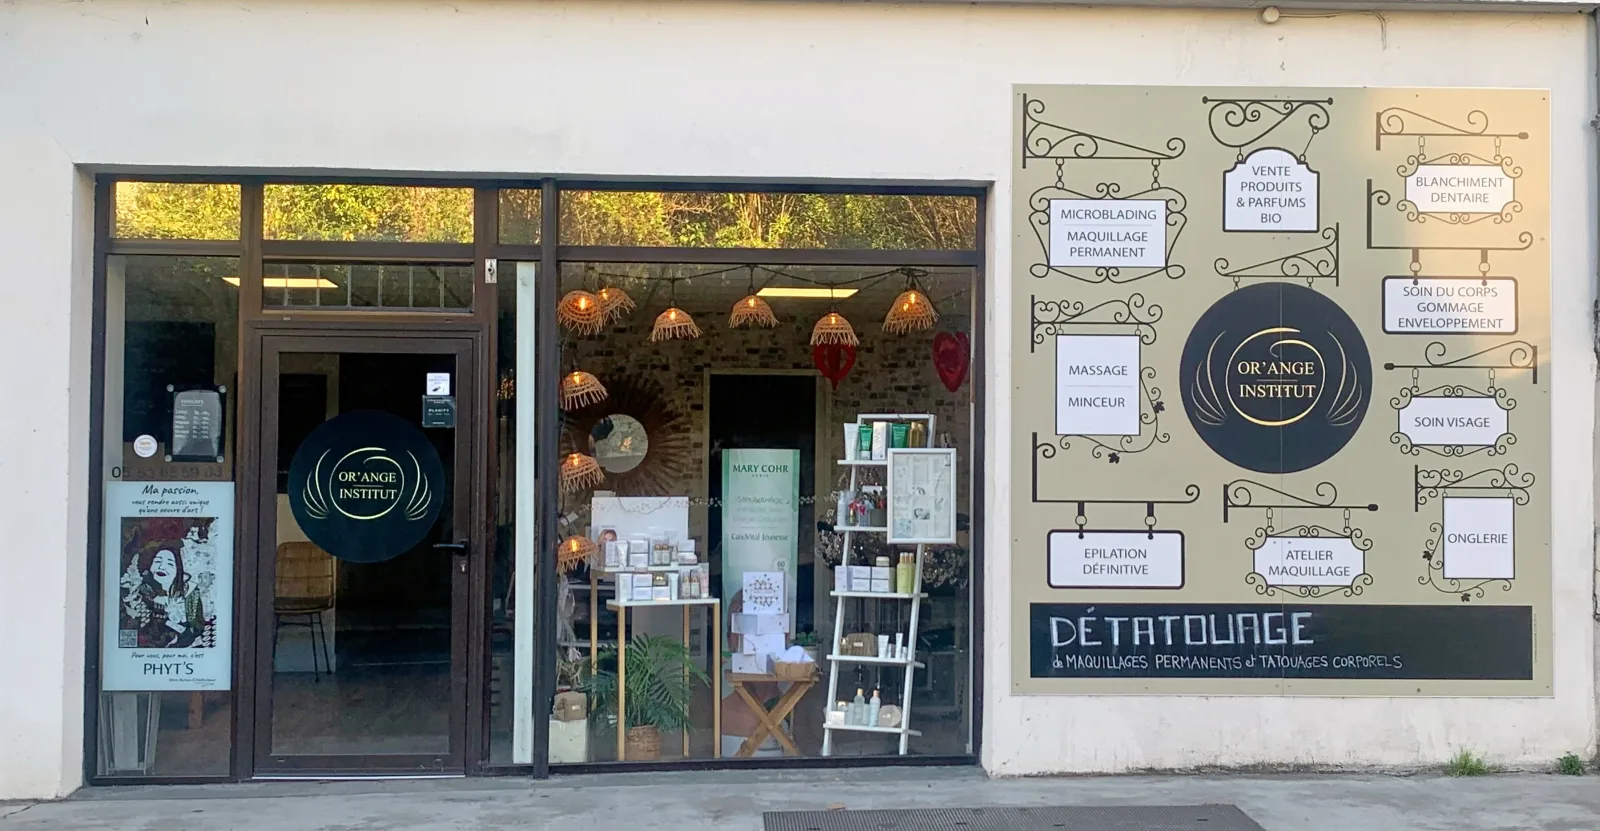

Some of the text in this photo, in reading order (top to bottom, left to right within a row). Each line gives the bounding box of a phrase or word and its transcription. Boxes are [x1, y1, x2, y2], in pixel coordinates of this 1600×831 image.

[1252, 166, 1291, 176] VENTE
[1241, 182, 1302, 192] PRODUITS
[1416, 177, 1504, 188] BLANCHIMENT
[1236, 197, 1306, 207] & PARFUMS
[1431, 192, 1489, 203] DENTAIRE
[1060, 209, 1157, 220] MICROBLADING
[1260, 213, 1282, 223] BIO
[1067, 231, 1148, 243] MAQUILLAGE
[1070, 247, 1146, 258] PERMANENT
[1403, 286, 1498, 297] SOIN DU CORPS
[1417, 302, 1484, 313] GOMMAGE
[1398, 318, 1503, 329] ENVELOPPEMENT
[1068, 365, 1128, 376] MASSAGE
[1237, 361, 1314, 375] OR'ANGE
[1239, 384, 1316, 398] INSTITUT
[1068, 397, 1125, 408] MINCEUR
[1414, 417, 1490, 427] SOIN VISAGE
[733, 464, 789, 473] MARY COHR
[338, 471, 397, 483] OR'ANGE
[142, 484, 199, 497] Ma passion,
[339, 489, 397, 500] INSTITUT
[138, 506, 158, 515] qu'une
[181, 505, 198, 513] d'art
[1447, 533, 1508, 544] ONGLERIE
[1084, 548, 1147, 559] EPILATION
[1286, 550, 1333, 561] ATELIER
[1083, 561, 1149, 575] DÉFINITIVE
[1268, 565, 1351, 577] MAQUILLAGE
[1050, 606, 1314, 647] DÉTATOUAGE
[131, 651, 145, 659] Pour
[162, 652, 177, 660] pour
[190, 651, 205, 659] c'est
[1052, 654, 1403, 670] de MAQUILLAGES PERMANENTS et TATOUAGES CORPORELS
[143, 661, 194, 675] PHYT'S
